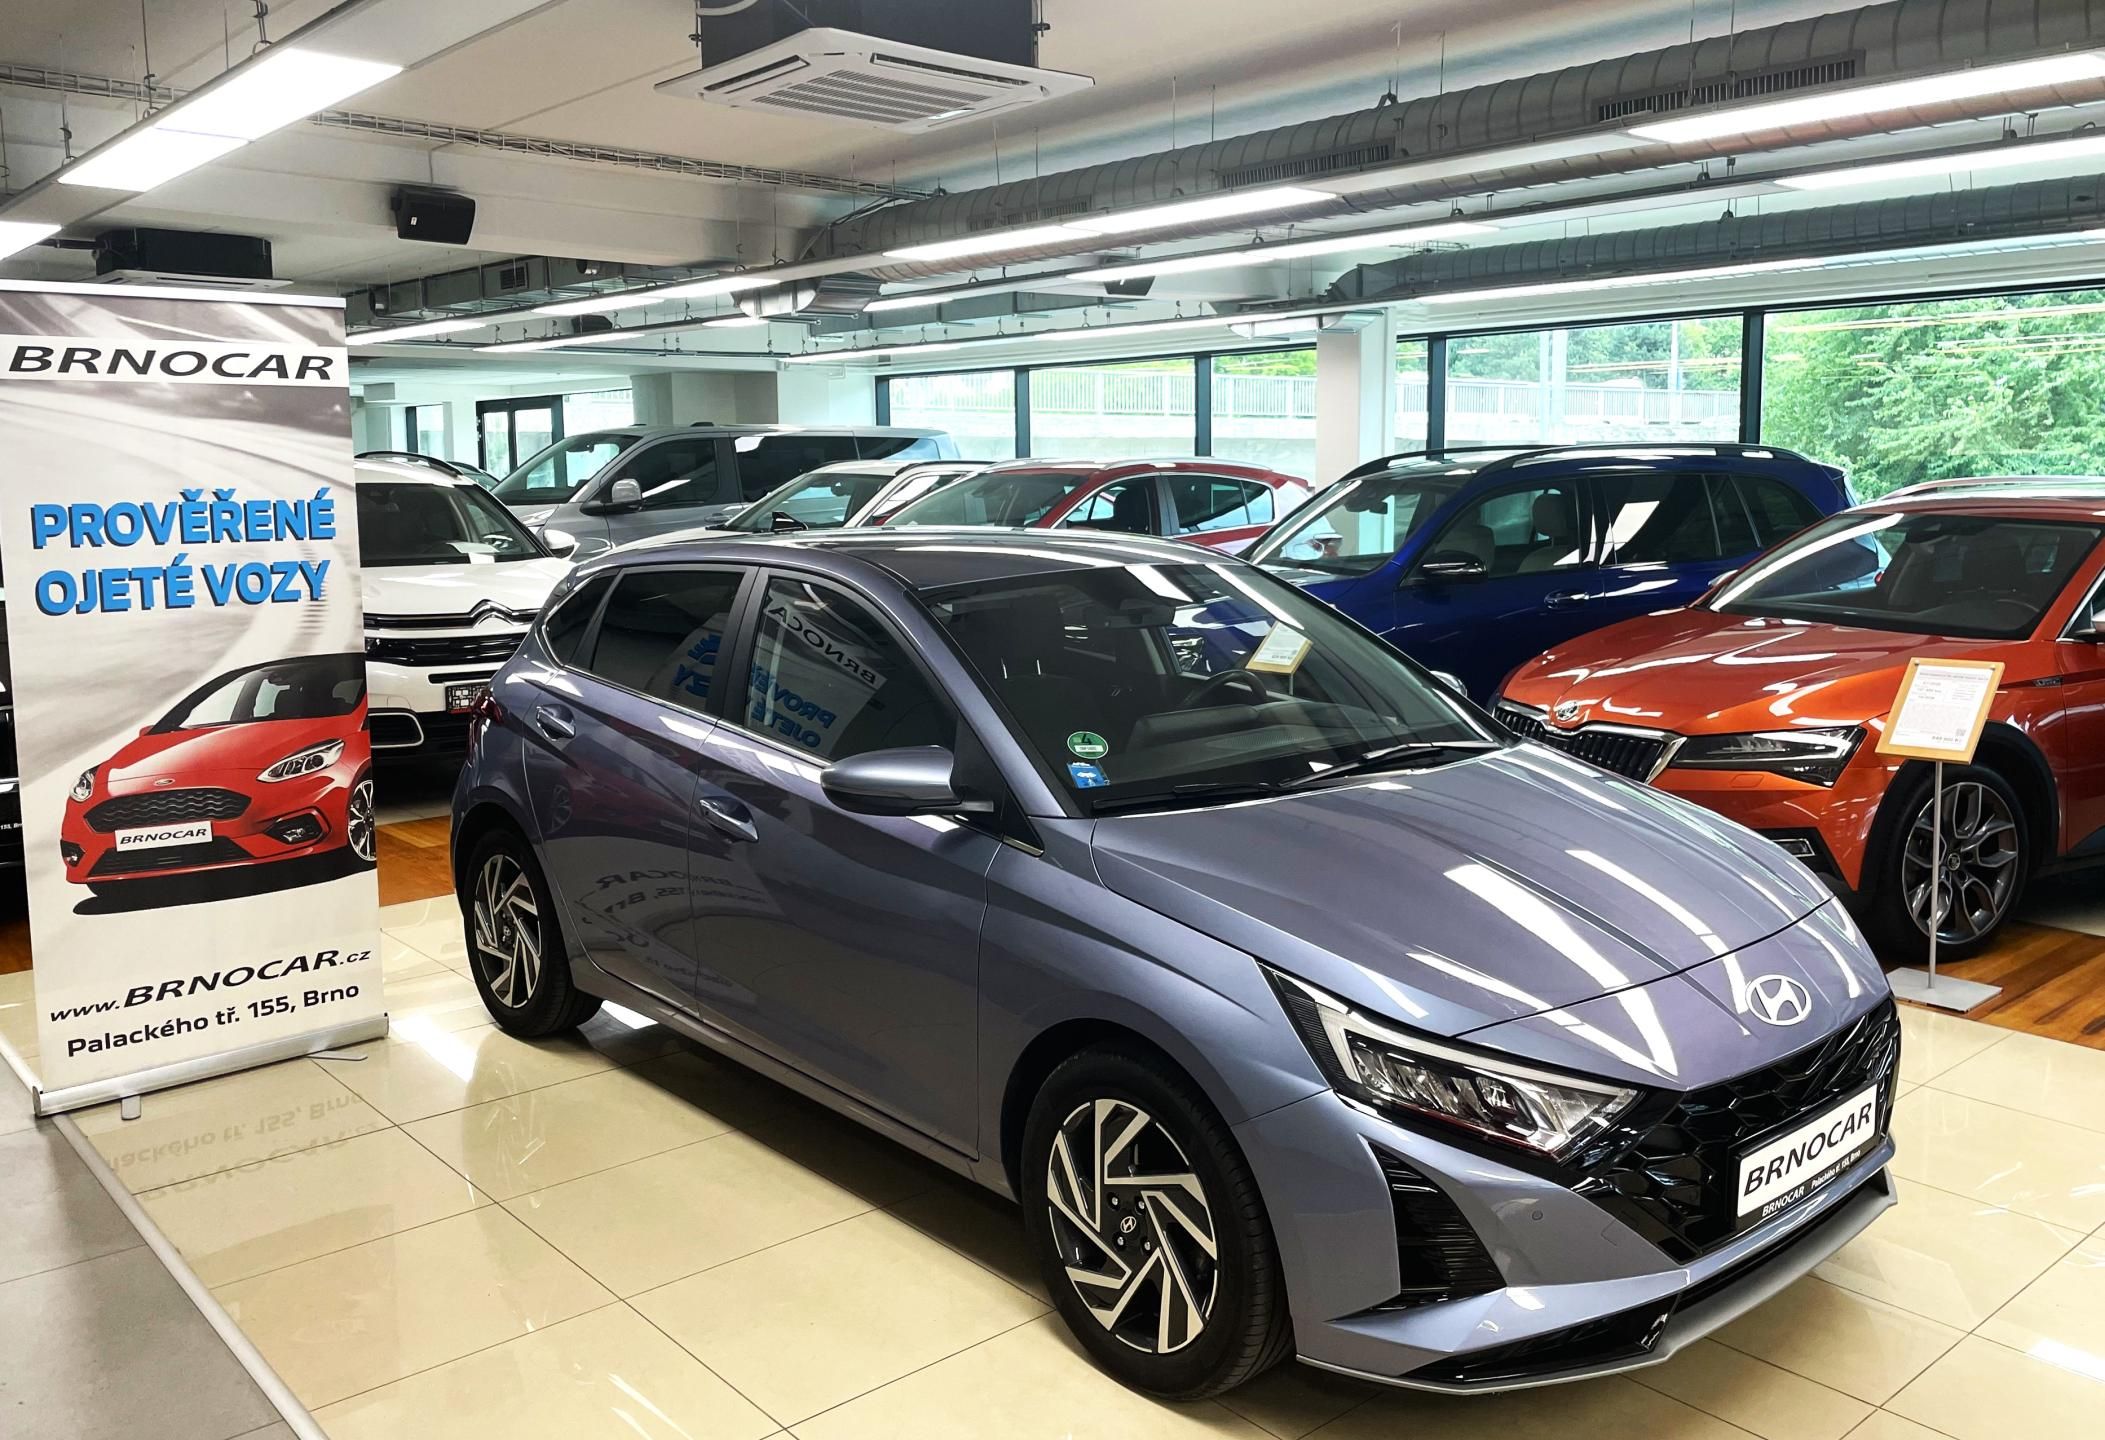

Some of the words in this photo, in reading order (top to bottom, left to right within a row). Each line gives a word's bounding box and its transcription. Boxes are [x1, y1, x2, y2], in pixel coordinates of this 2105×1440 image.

[8, 346, 334, 380] BRNOCAR
[31, 487, 336, 549] PROVĚŘENÉ
[35, 553, 195, 616] OJETÉ
[201, 560, 331, 607] VOZY
[120, 829, 207, 845] BRNOCAR
[50, 950, 371, 1022] www.BRNOCAR.cz
[67, 1016, 209, 1057] Palackého
[215, 1007, 240, 1025] tř.
[247, 996, 297, 1019] 155,
[303, 985, 360, 1008] Brno
[1743, 1102, 1872, 1197] BRNOCAR
[1761, 1186, 1805, 1217] BRNOCAR
